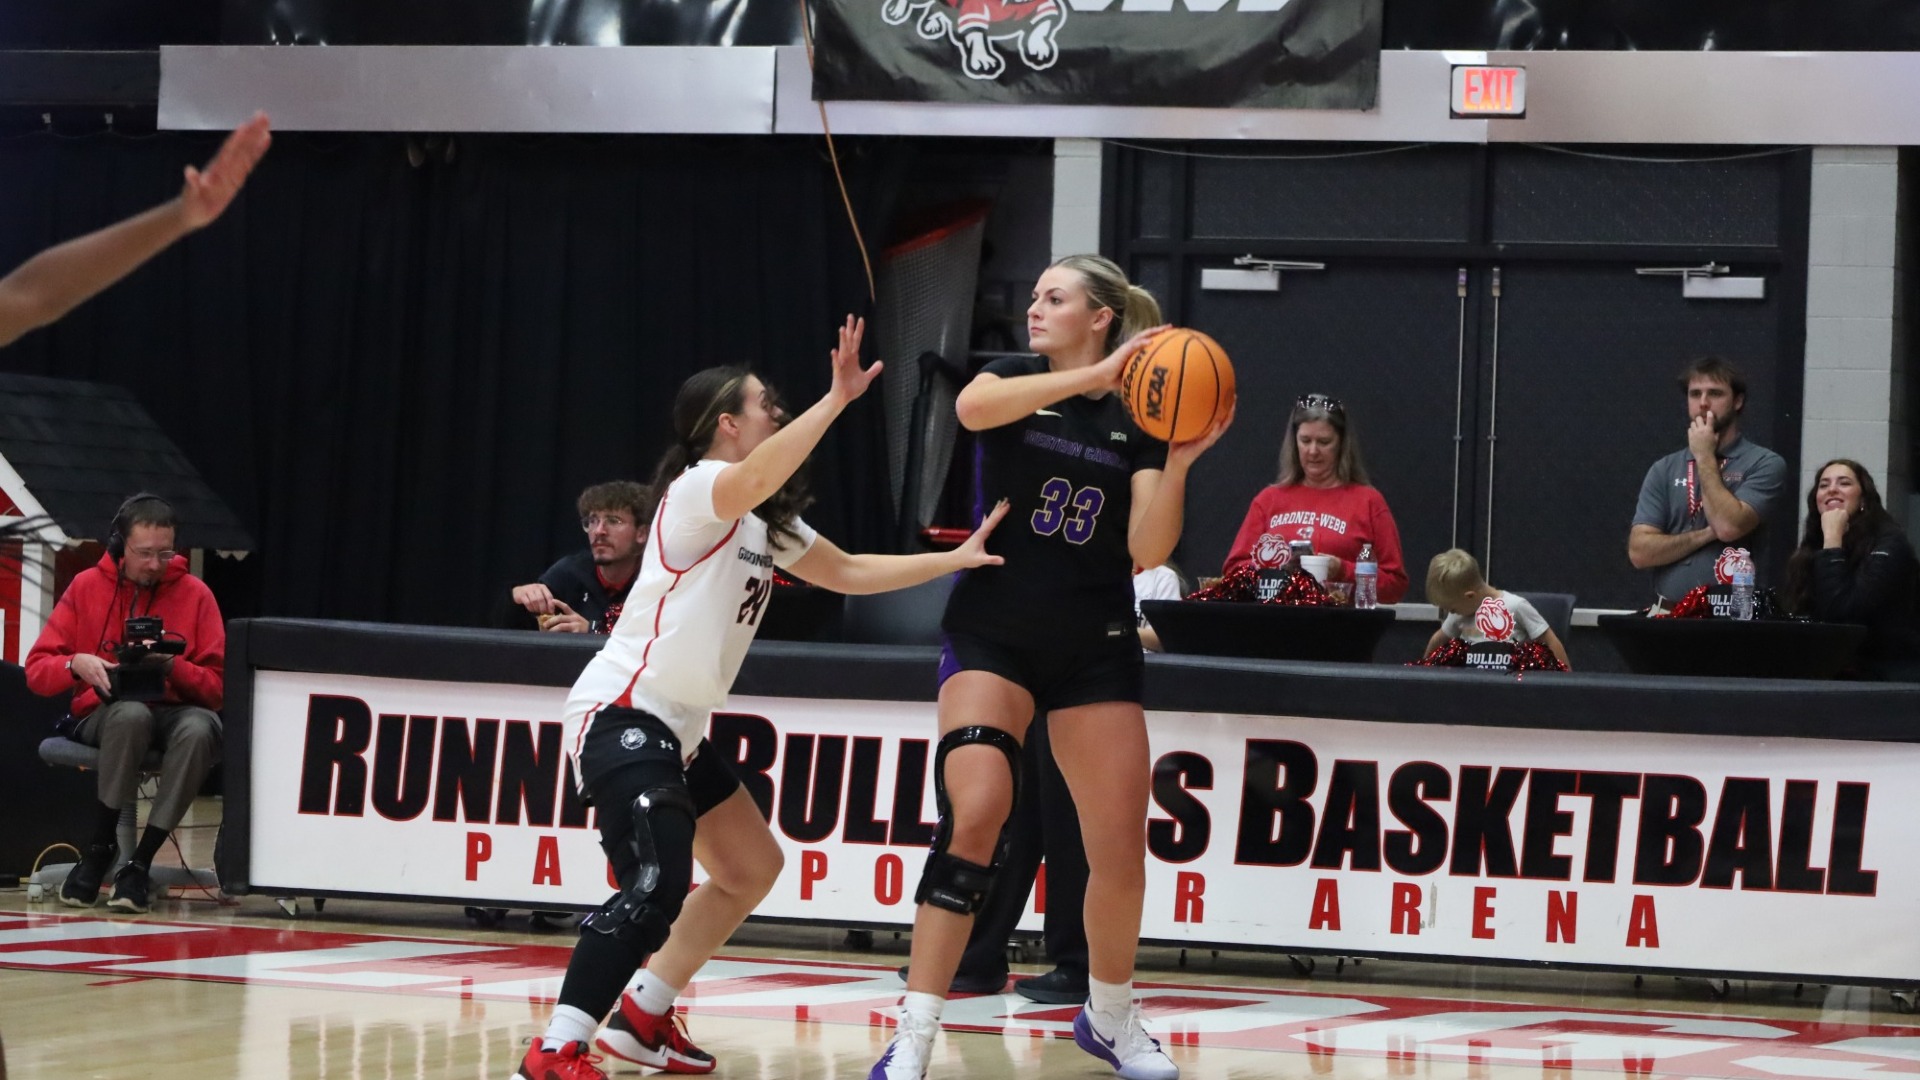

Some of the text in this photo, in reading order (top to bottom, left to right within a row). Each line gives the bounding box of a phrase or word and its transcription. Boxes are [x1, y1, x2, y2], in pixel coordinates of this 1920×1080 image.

[1464, 69, 1518, 110] EXIT
[1146, 365, 1169, 421] NCAA
[1031, 477, 1105, 545] 33
[1270, 511, 1347, 535] GARDNER-WEBB
[1466, 653, 1511, 665] BULLDO
[298, 693, 600, 830] RUNN
[1234, 738, 1878, 897] BASKETBALL
[1308, 878, 1660, 949] ARENA
